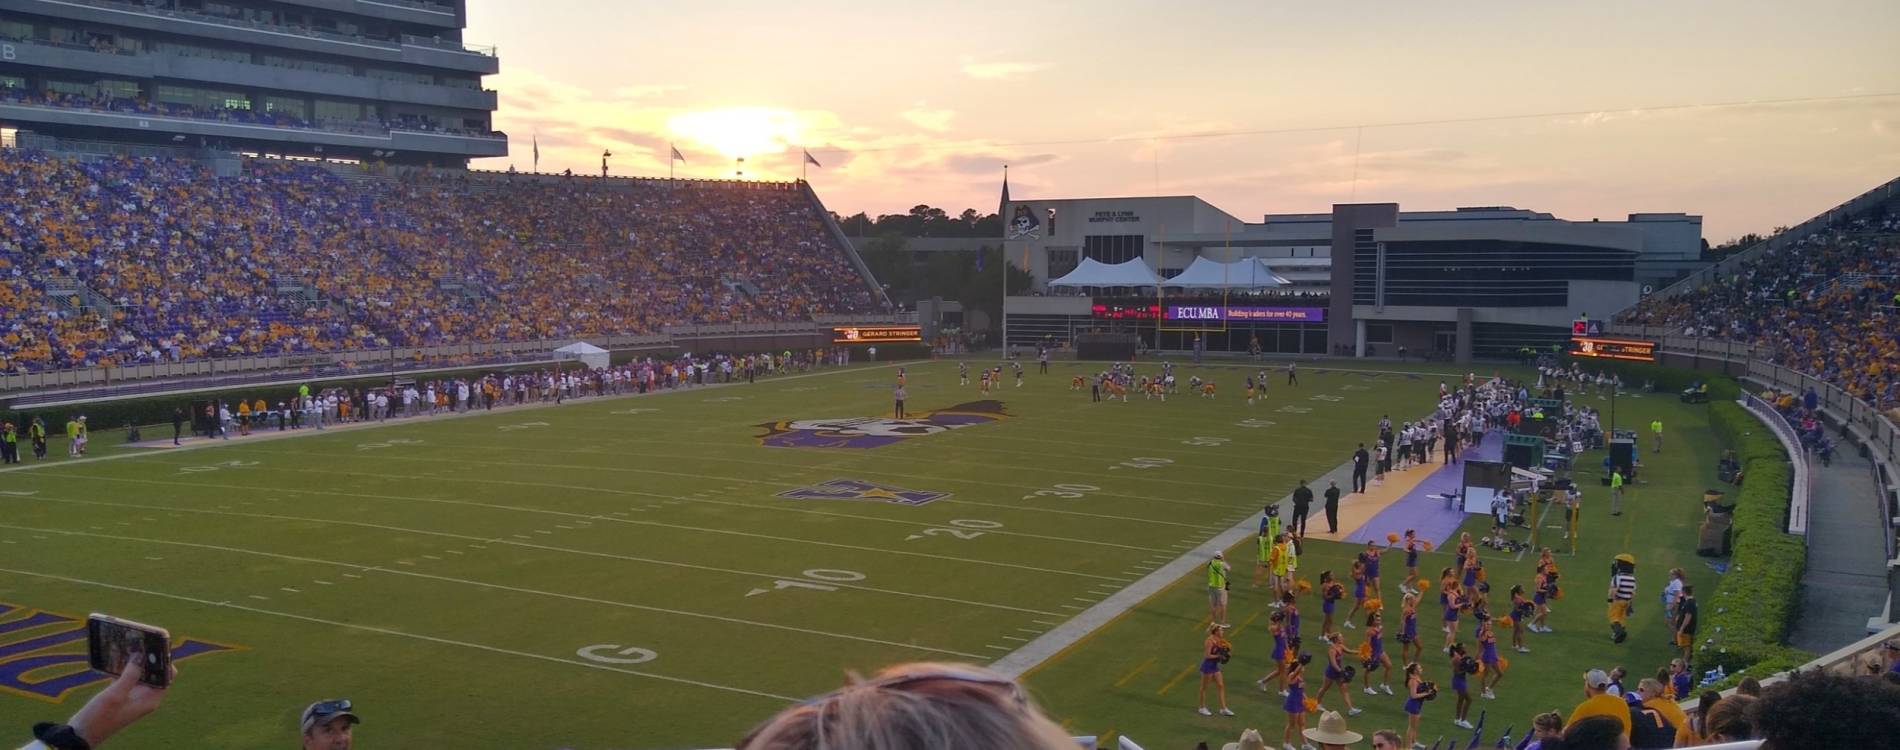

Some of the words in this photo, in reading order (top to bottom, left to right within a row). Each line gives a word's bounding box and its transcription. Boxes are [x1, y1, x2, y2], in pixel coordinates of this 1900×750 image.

[1177, 307, 1197, 319] ECU
[1198, 307, 1219, 319] MBA
[1034, 484, 1101, 499] 30
[923, 518, 1005, 540] 20
[774, 568, 866, 592] 10
[575, 643, 658, 664] G
